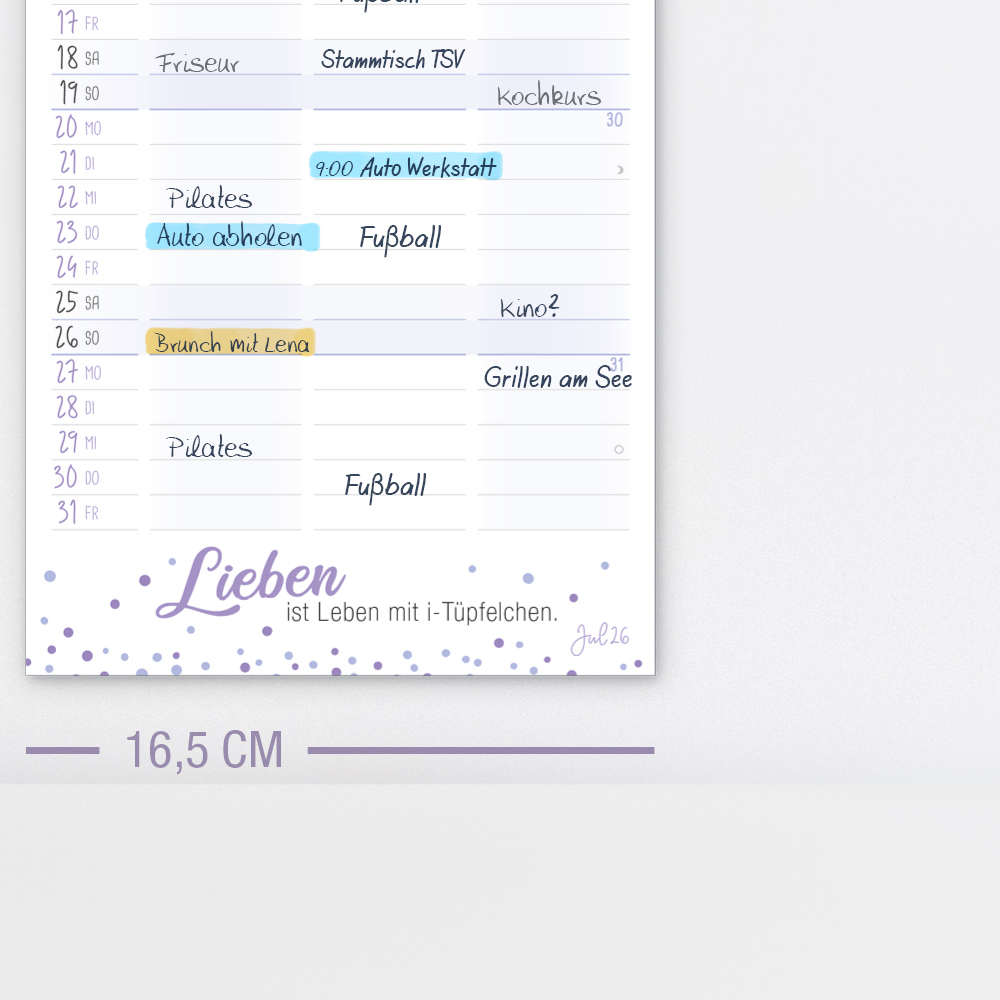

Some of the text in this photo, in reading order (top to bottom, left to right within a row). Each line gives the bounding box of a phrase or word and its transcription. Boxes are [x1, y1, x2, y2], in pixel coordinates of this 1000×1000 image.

[58, 10, 99, 34] 17 FR
[58, 45, 100, 69] 18 SA
[156, 53, 239, 72] Friseur
[322, 49, 465, 69] Stammtisch TSV
[60, 80, 100, 104] 19 SO
[498, 81, 601, 105] Kochkurs
[56, 115, 102, 138] 20 MO
[606, 111, 624, 127] 30
[59, 148, 95, 175] 21 DI
[316, 157, 497, 178] 9:00 Auto Werkstatt
[58, 186, 97, 208] 22 MI
[166, 185, 252, 208] Pilates
[57, 221, 100, 243] 23 DO
[157, 223, 302, 246] Auto abholen
[360, 225, 441, 257] Fußball
[57, 256, 99, 278] 24 FR
[56, 290, 100, 313] 25 SA
[501, 294, 559, 317] Kino?
[56, 325, 100, 348] 26 SO
[154, 331, 309, 352] Brunch mit Lena
[57, 359, 102, 383] 27 MO
[485, 365, 632, 388] Grillen am See
[609, 357, 625, 375] 31
[57, 395, 95, 418] 28 DI
[59, 431, 97, 453] 29 MI
[166, 434, 252, 457] Pilates
[54, 465, 100, 488] 30 DO
[345, 473, 426, 505] Fußball
[58, 498, 99, 525] 31 FR
[156, 546, 347, 619] Lieben
[288, 602, 556, 625] ist Leben mit i-Tüpfelchen.
